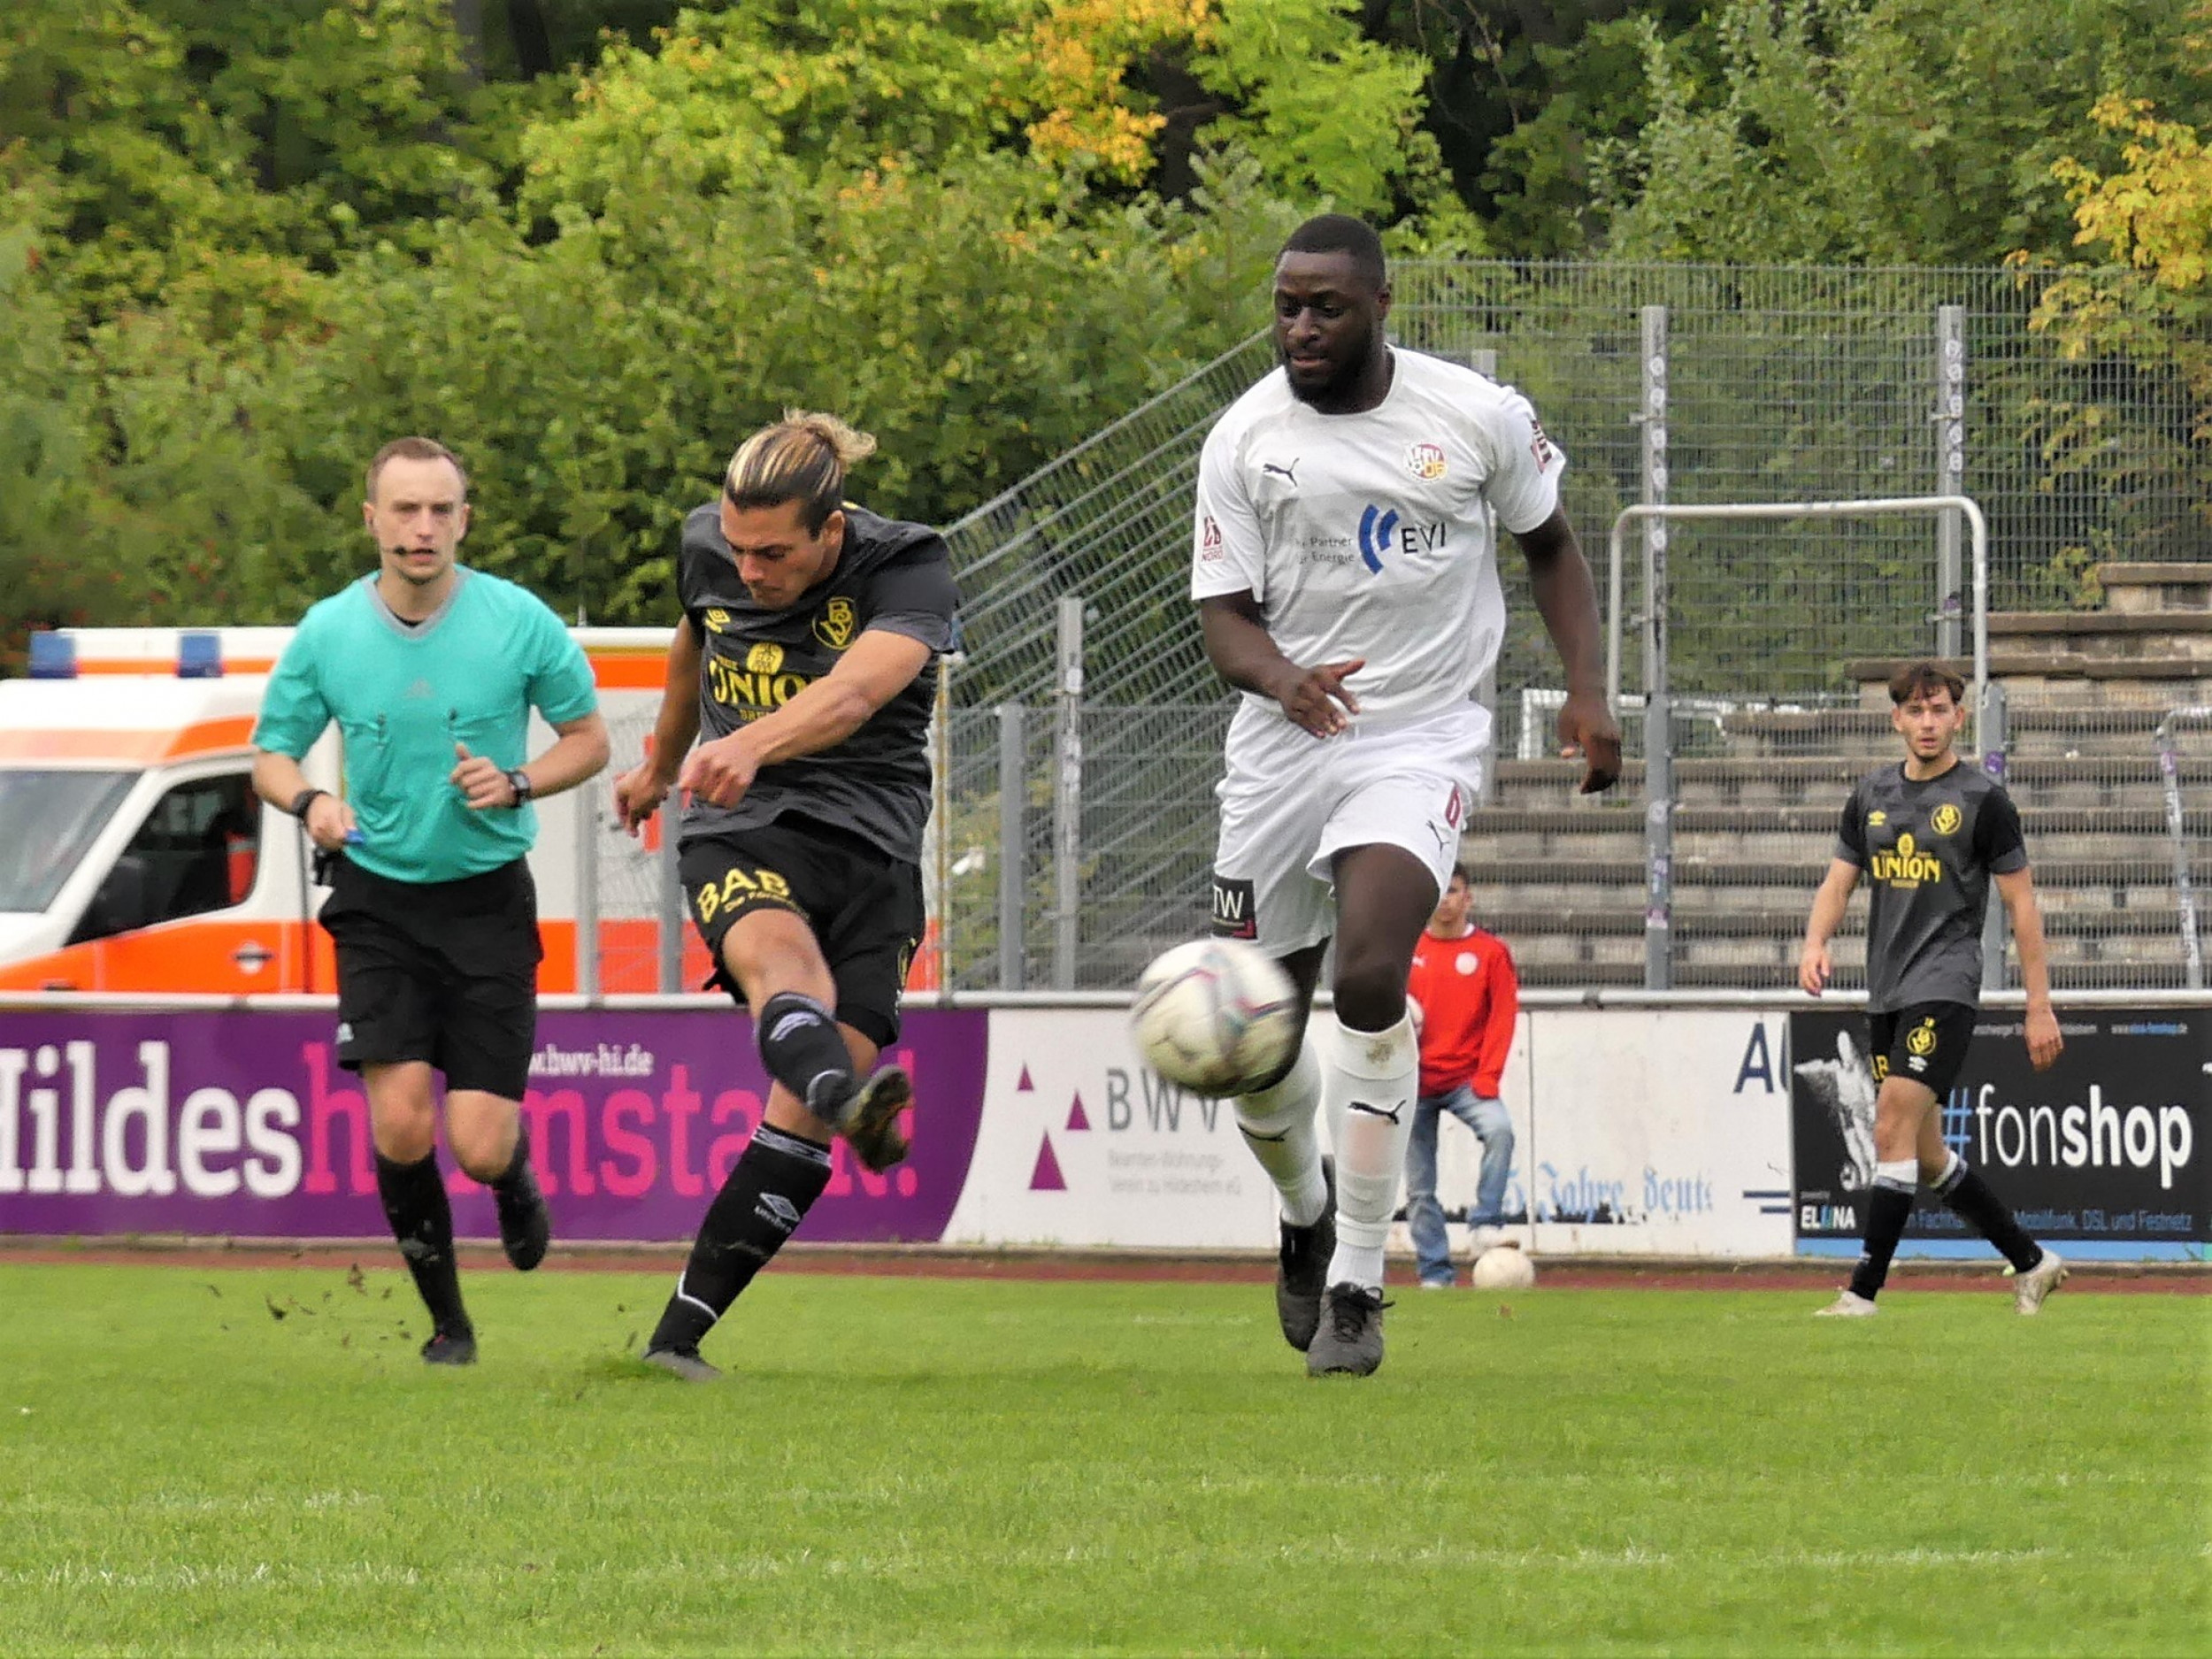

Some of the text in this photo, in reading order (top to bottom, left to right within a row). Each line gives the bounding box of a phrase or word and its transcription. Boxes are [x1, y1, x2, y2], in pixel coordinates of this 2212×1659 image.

[1310, 536, 1353, 548] Partner
[1401, 522, 1447, 555] EVI
[1311, 551, 1355, 565] Energie
[1871, 855, 1941, 884] UNION
[1733, 1022, 1790, 1094] A
[1942, 1084, 2193, 1189] #fonshop
